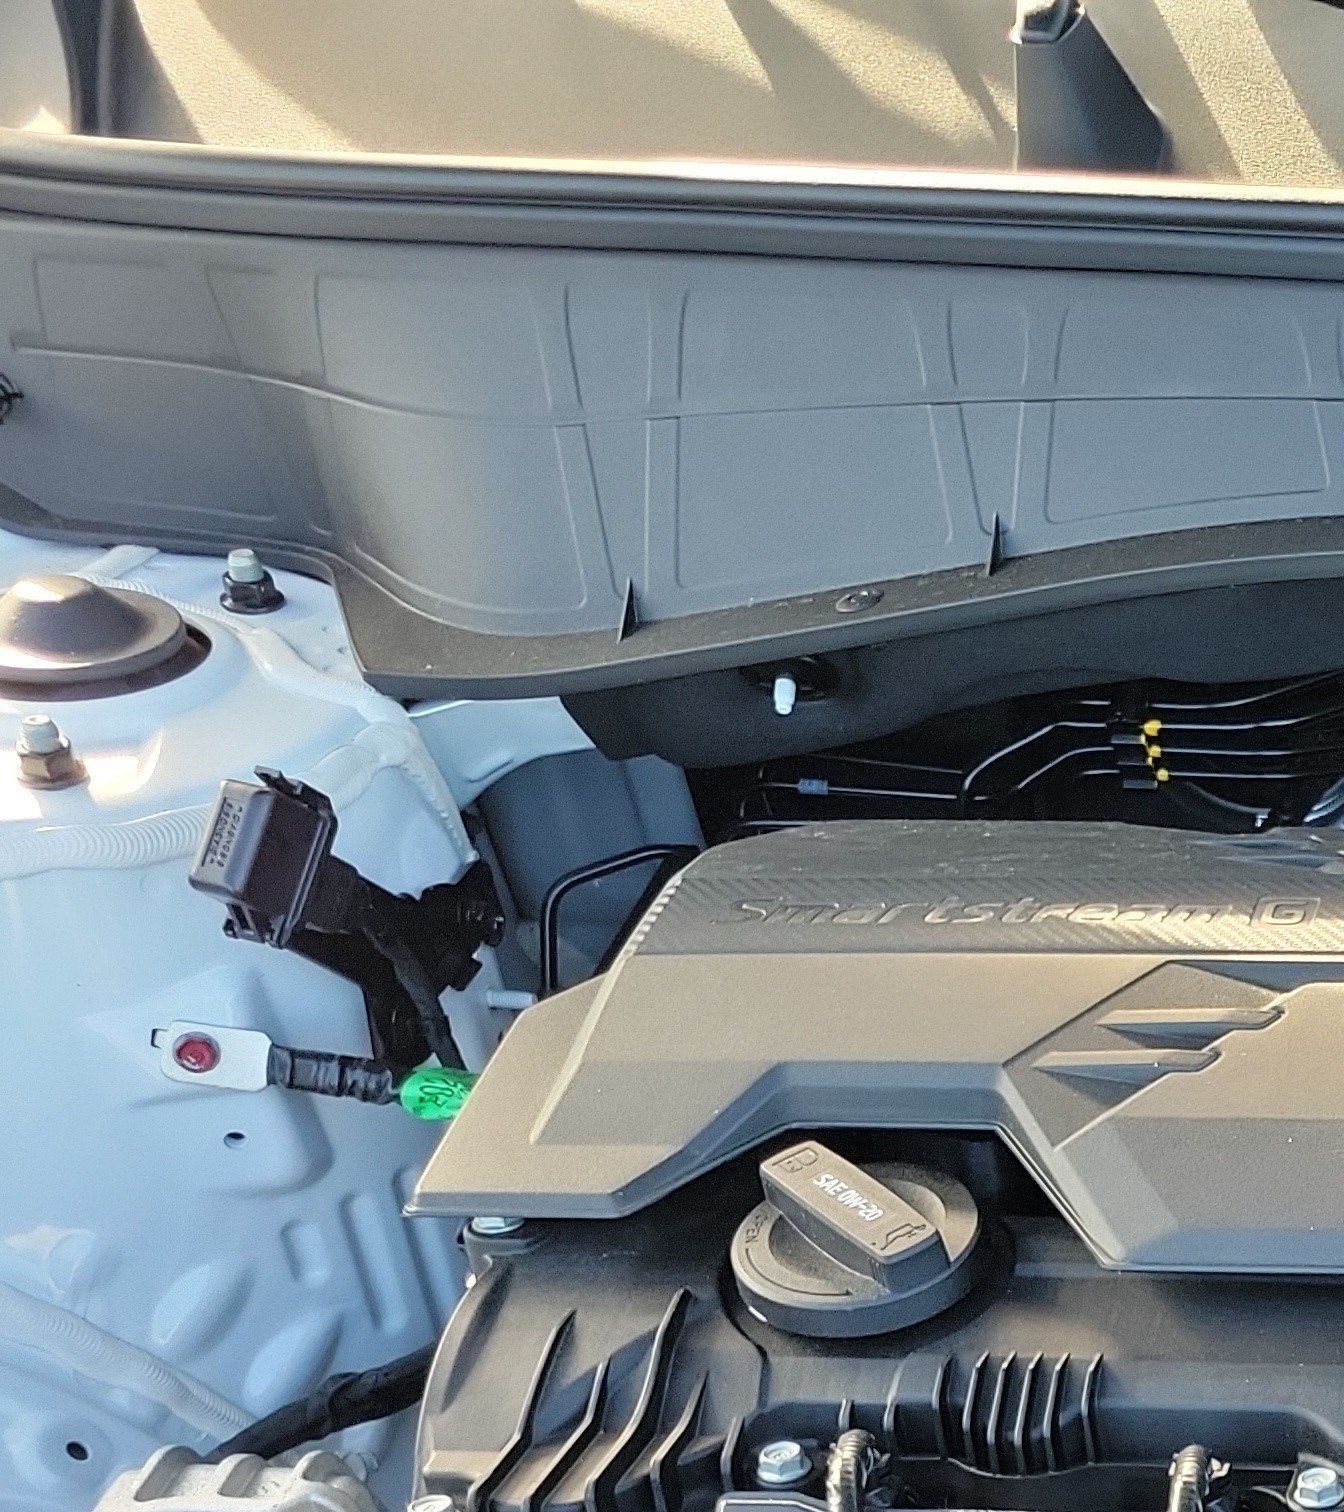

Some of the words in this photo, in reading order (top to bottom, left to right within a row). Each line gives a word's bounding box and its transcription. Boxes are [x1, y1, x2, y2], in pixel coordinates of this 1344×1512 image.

[711, 896, 1247, 926] Smartstream
[813, 1173, 846, 1197] SAE
[838, 1186, 884, 1222] 0W-20
